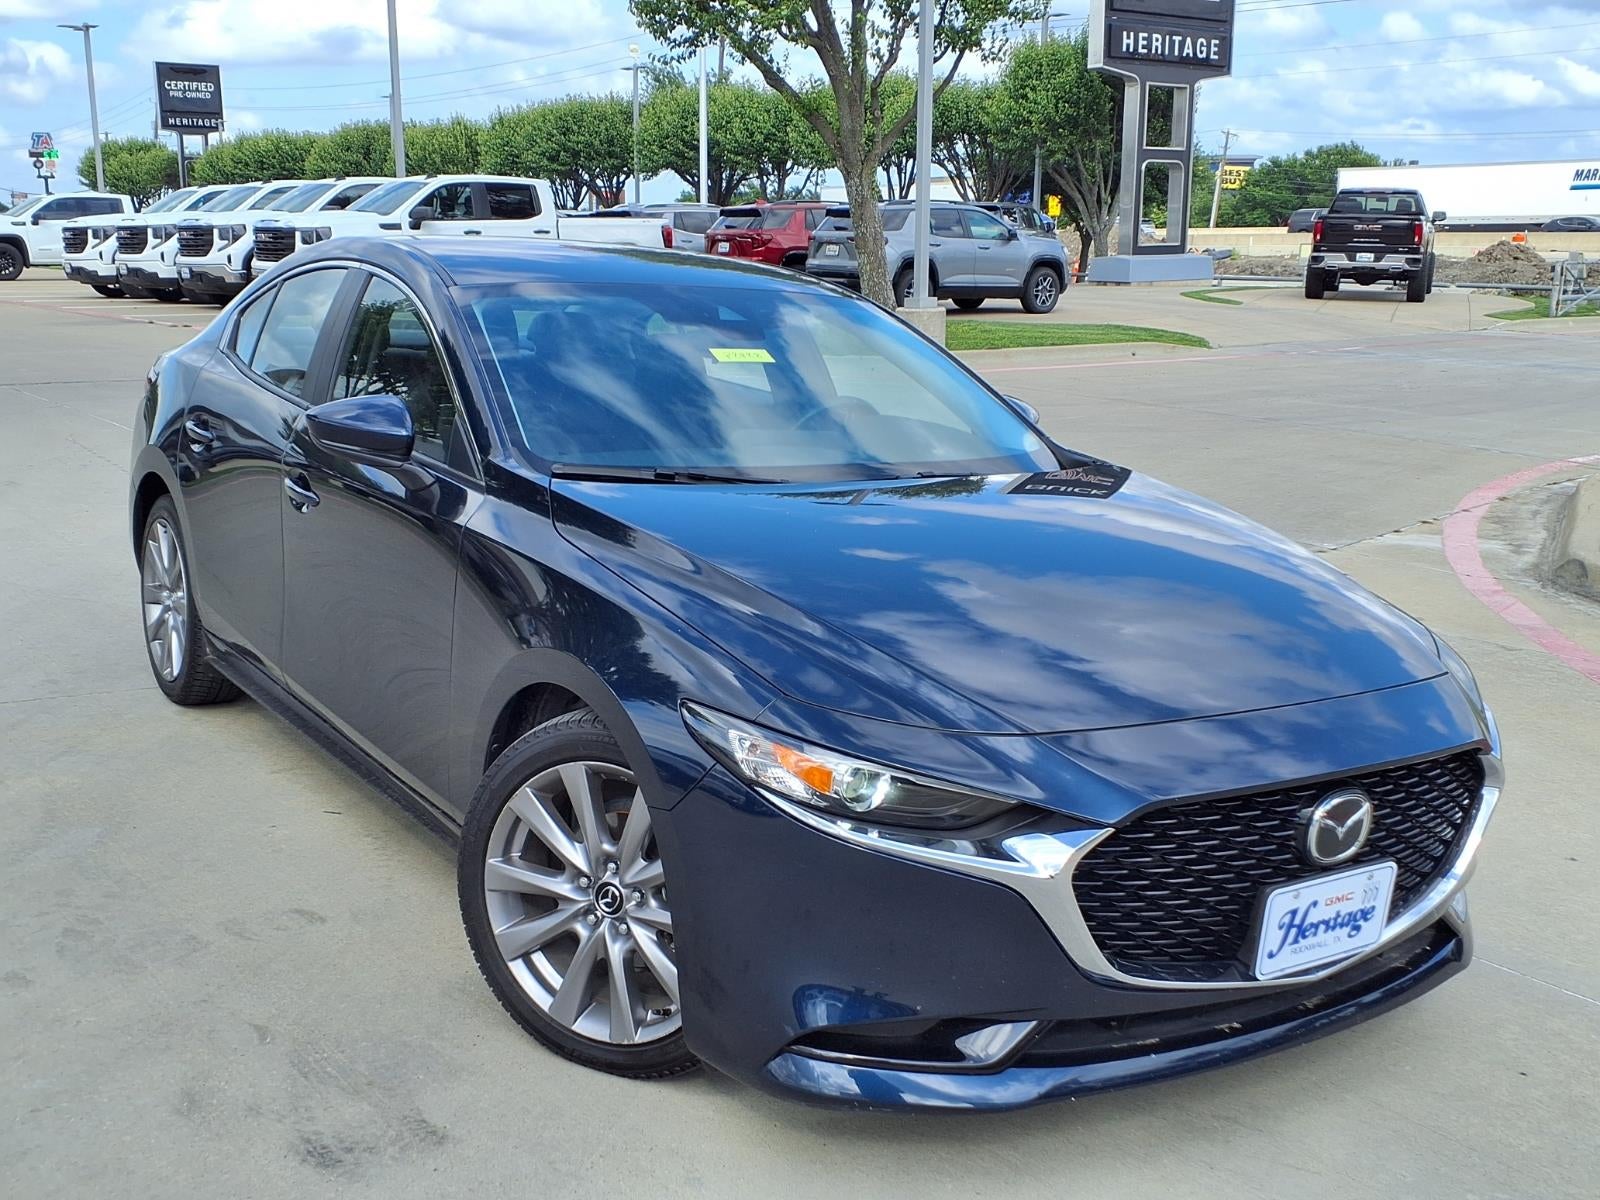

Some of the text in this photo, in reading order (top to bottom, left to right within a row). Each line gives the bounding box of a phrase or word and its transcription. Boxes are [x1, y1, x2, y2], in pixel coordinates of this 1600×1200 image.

[1122, 31, 1220, 59] HERITAGE
[164, 80, 215, 92] CERTIFIED
[169, 91, 212, 99] PRE-OWNED
[168, 117, 217, 127] HERITAGE
[1221, 177, 1244, 185] BUY
[1573, 168, 1600, 182] MAR
[1325, 891, 1355, 907] GMC
[1266, 899, 1377, 960] Heritage
